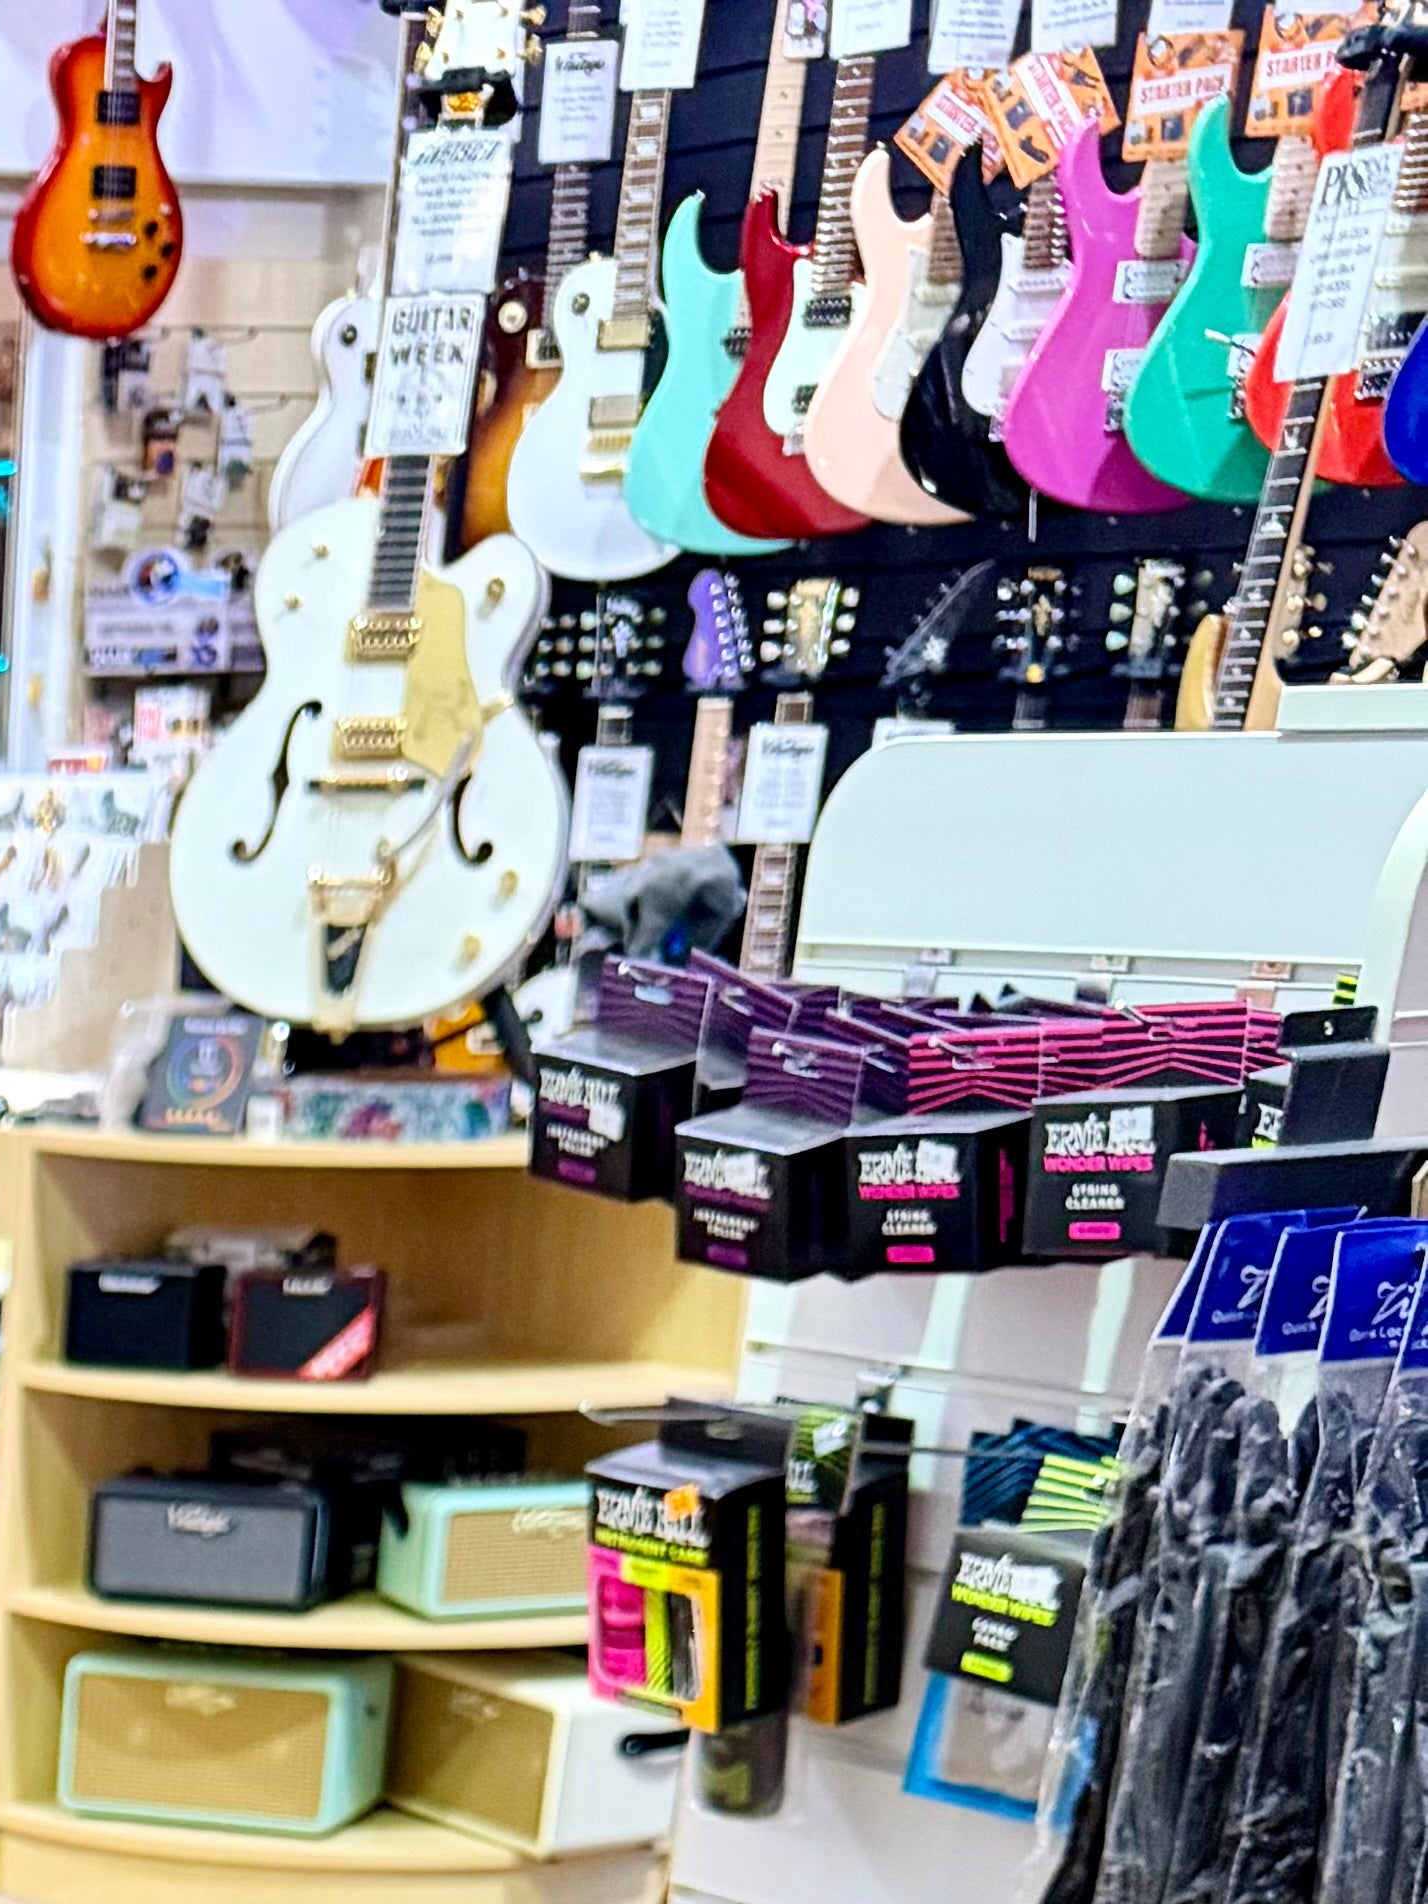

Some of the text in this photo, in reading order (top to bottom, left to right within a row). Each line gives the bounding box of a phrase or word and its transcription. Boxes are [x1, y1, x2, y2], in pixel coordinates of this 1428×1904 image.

[1141, 79, 1191, 104] STARTER
[1043, 1111, 1106, 1156] ERNIE
[858, 1141, 915, 1184] ERNIE
[1043, 1154, 1155, 1173] WONDER WIPES
